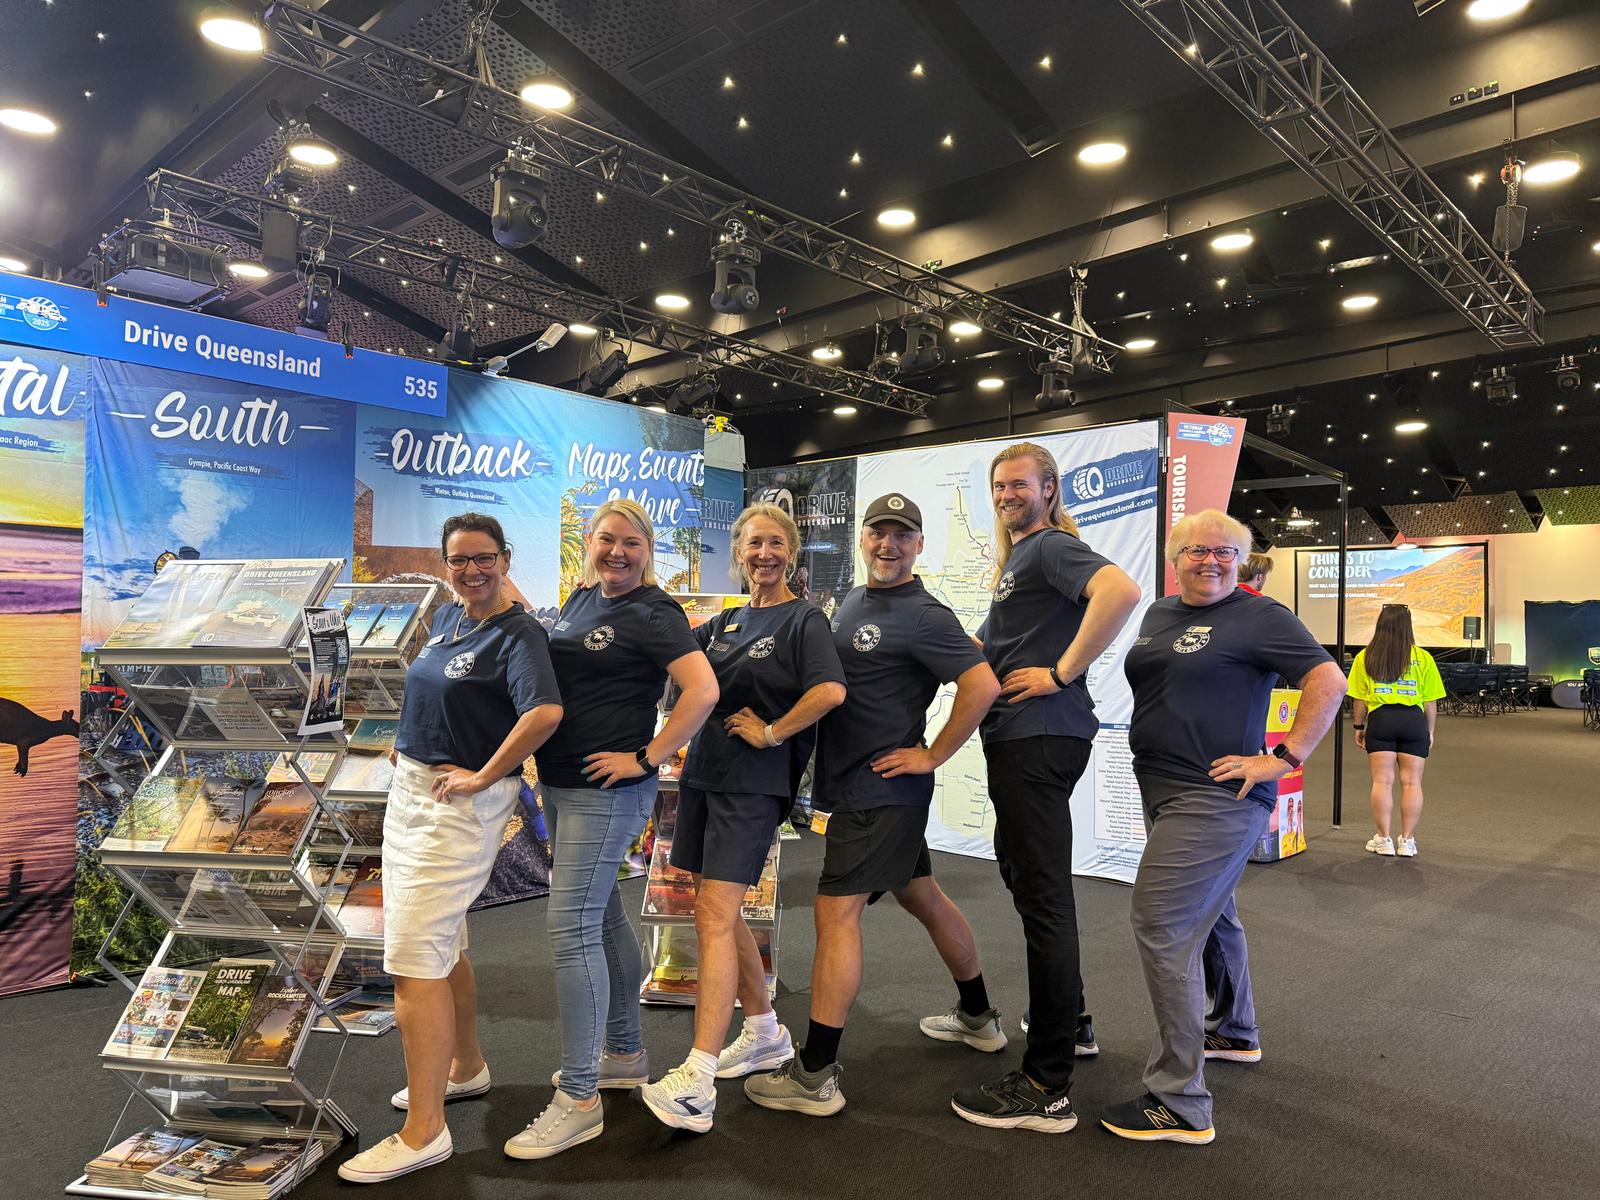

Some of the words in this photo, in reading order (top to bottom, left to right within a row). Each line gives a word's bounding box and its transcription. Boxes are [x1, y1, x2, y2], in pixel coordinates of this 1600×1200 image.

[32, 317, 50, 327] 2025
[124, 320, 188, 353] Drive
[195, 335, 321, 378] Queensland
[404, 376, 438, 399] 535
[150, 391, 295, 447] South
[14, 436, 39, 447] Region
[391, 428, 535, 478] Outback
[188, 458, 213, 469] Gympie,
[213, 461, 232, 471] Pacific
[233, 463, 249, 472] Coast
[249, 466, 261, 475] Way
[1104, 460, 1144, 482] DRIVE
[1106, 474, 1144, 488] QUEENSLAND
[452, 489, 470, 498] Outback
[470, 491, 495, 501] Queensland
[701, 497, 735, 522] RIVE
[797, 491, 847, 518] DRIVE
[798, 516, 846, 528] QUEENSLAND
[1310, 552, 1354, 566] THINS
[1358, 552, 1375, 564] TO
[243, 570, 267, 578] DRIVE
[268, 569, 318, 578] QUEENSLAND
[1308, 565, 1372, 579] CONSDER
[216, 968, 256, 980] DRIVE
[217, 985, 242, 997] MAP
[266, 991, 307, 1000] ROCKHAMPTON
[1044, 1096, 1070, 1115] HOKA
